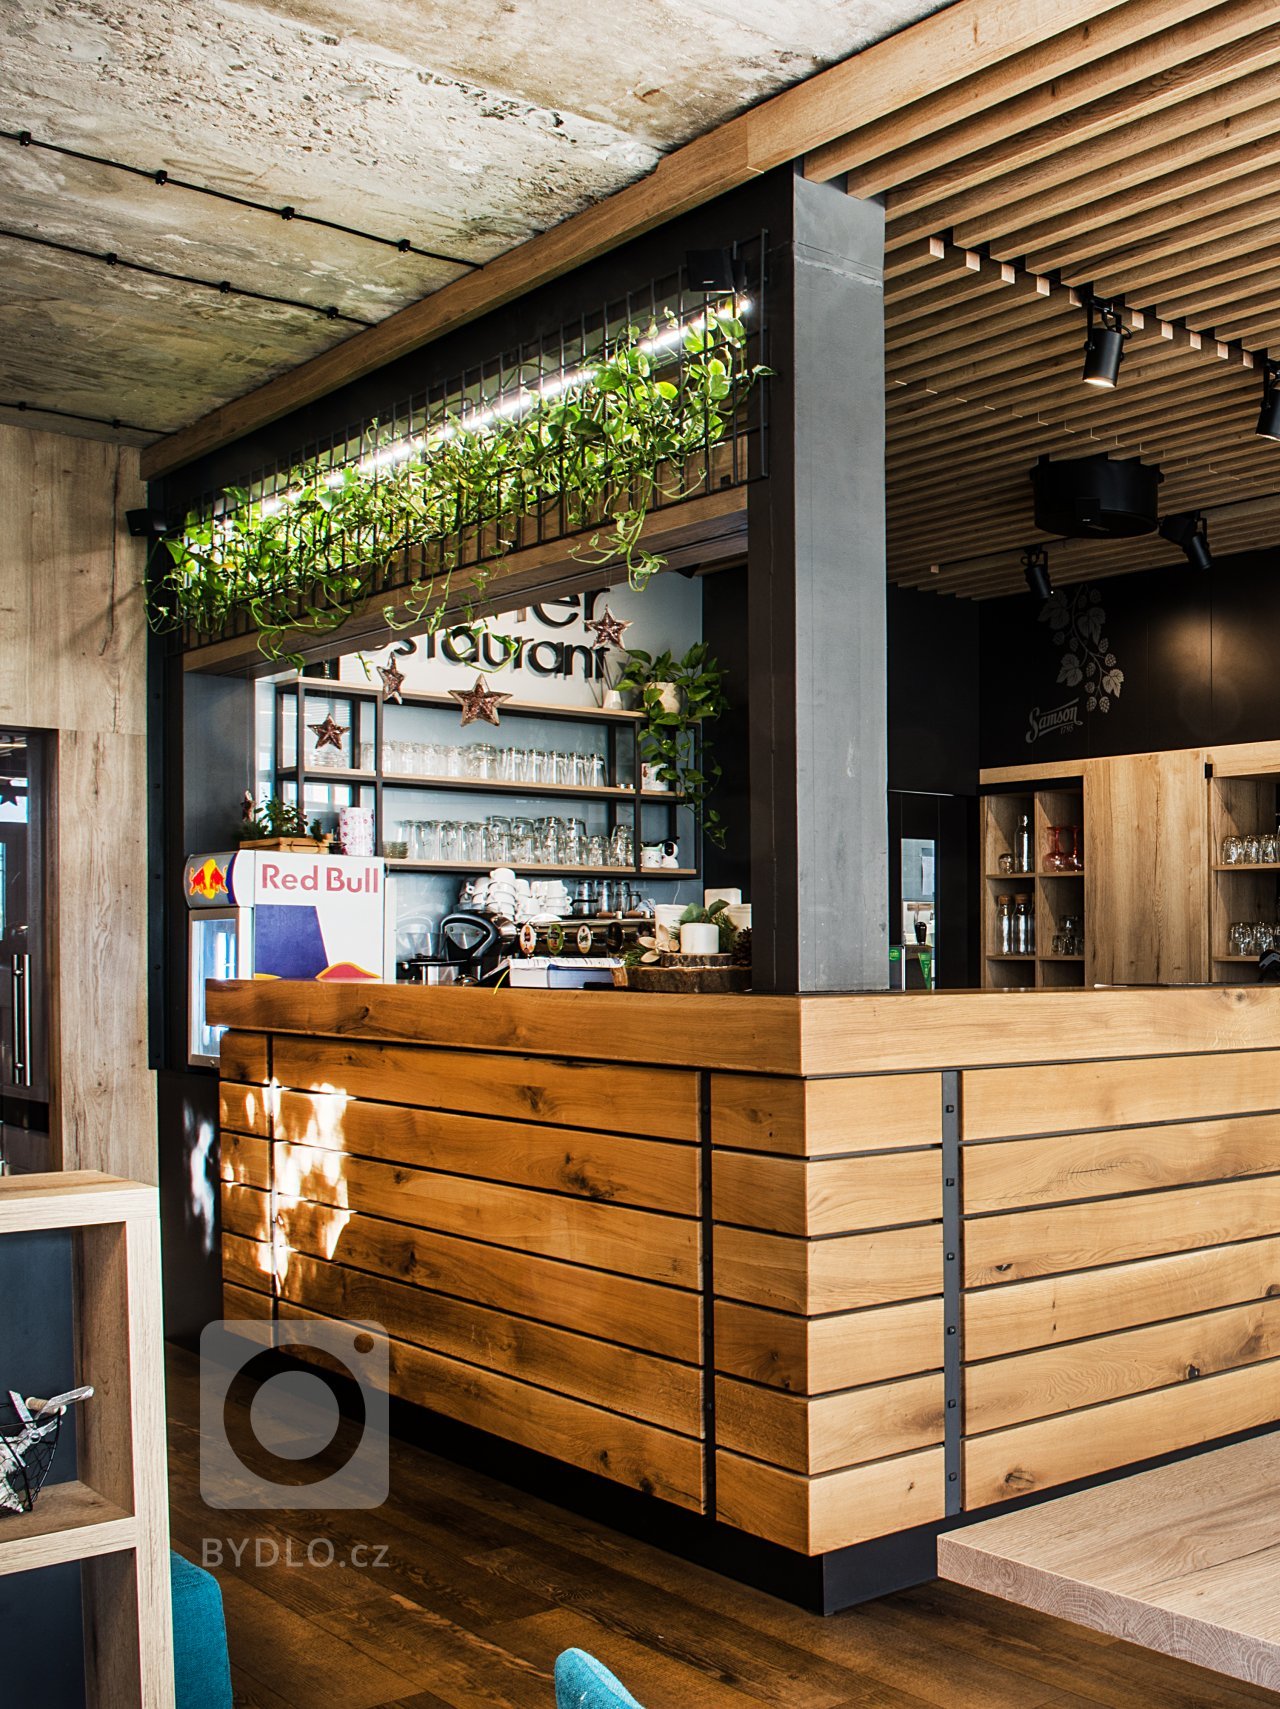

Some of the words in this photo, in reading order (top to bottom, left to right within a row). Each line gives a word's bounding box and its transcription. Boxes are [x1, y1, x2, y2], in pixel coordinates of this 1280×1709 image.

[1025, 697, 1084, 743] Samson
[262, 863, 319, 891] Red
[326, 866, 379, 893] Bull
